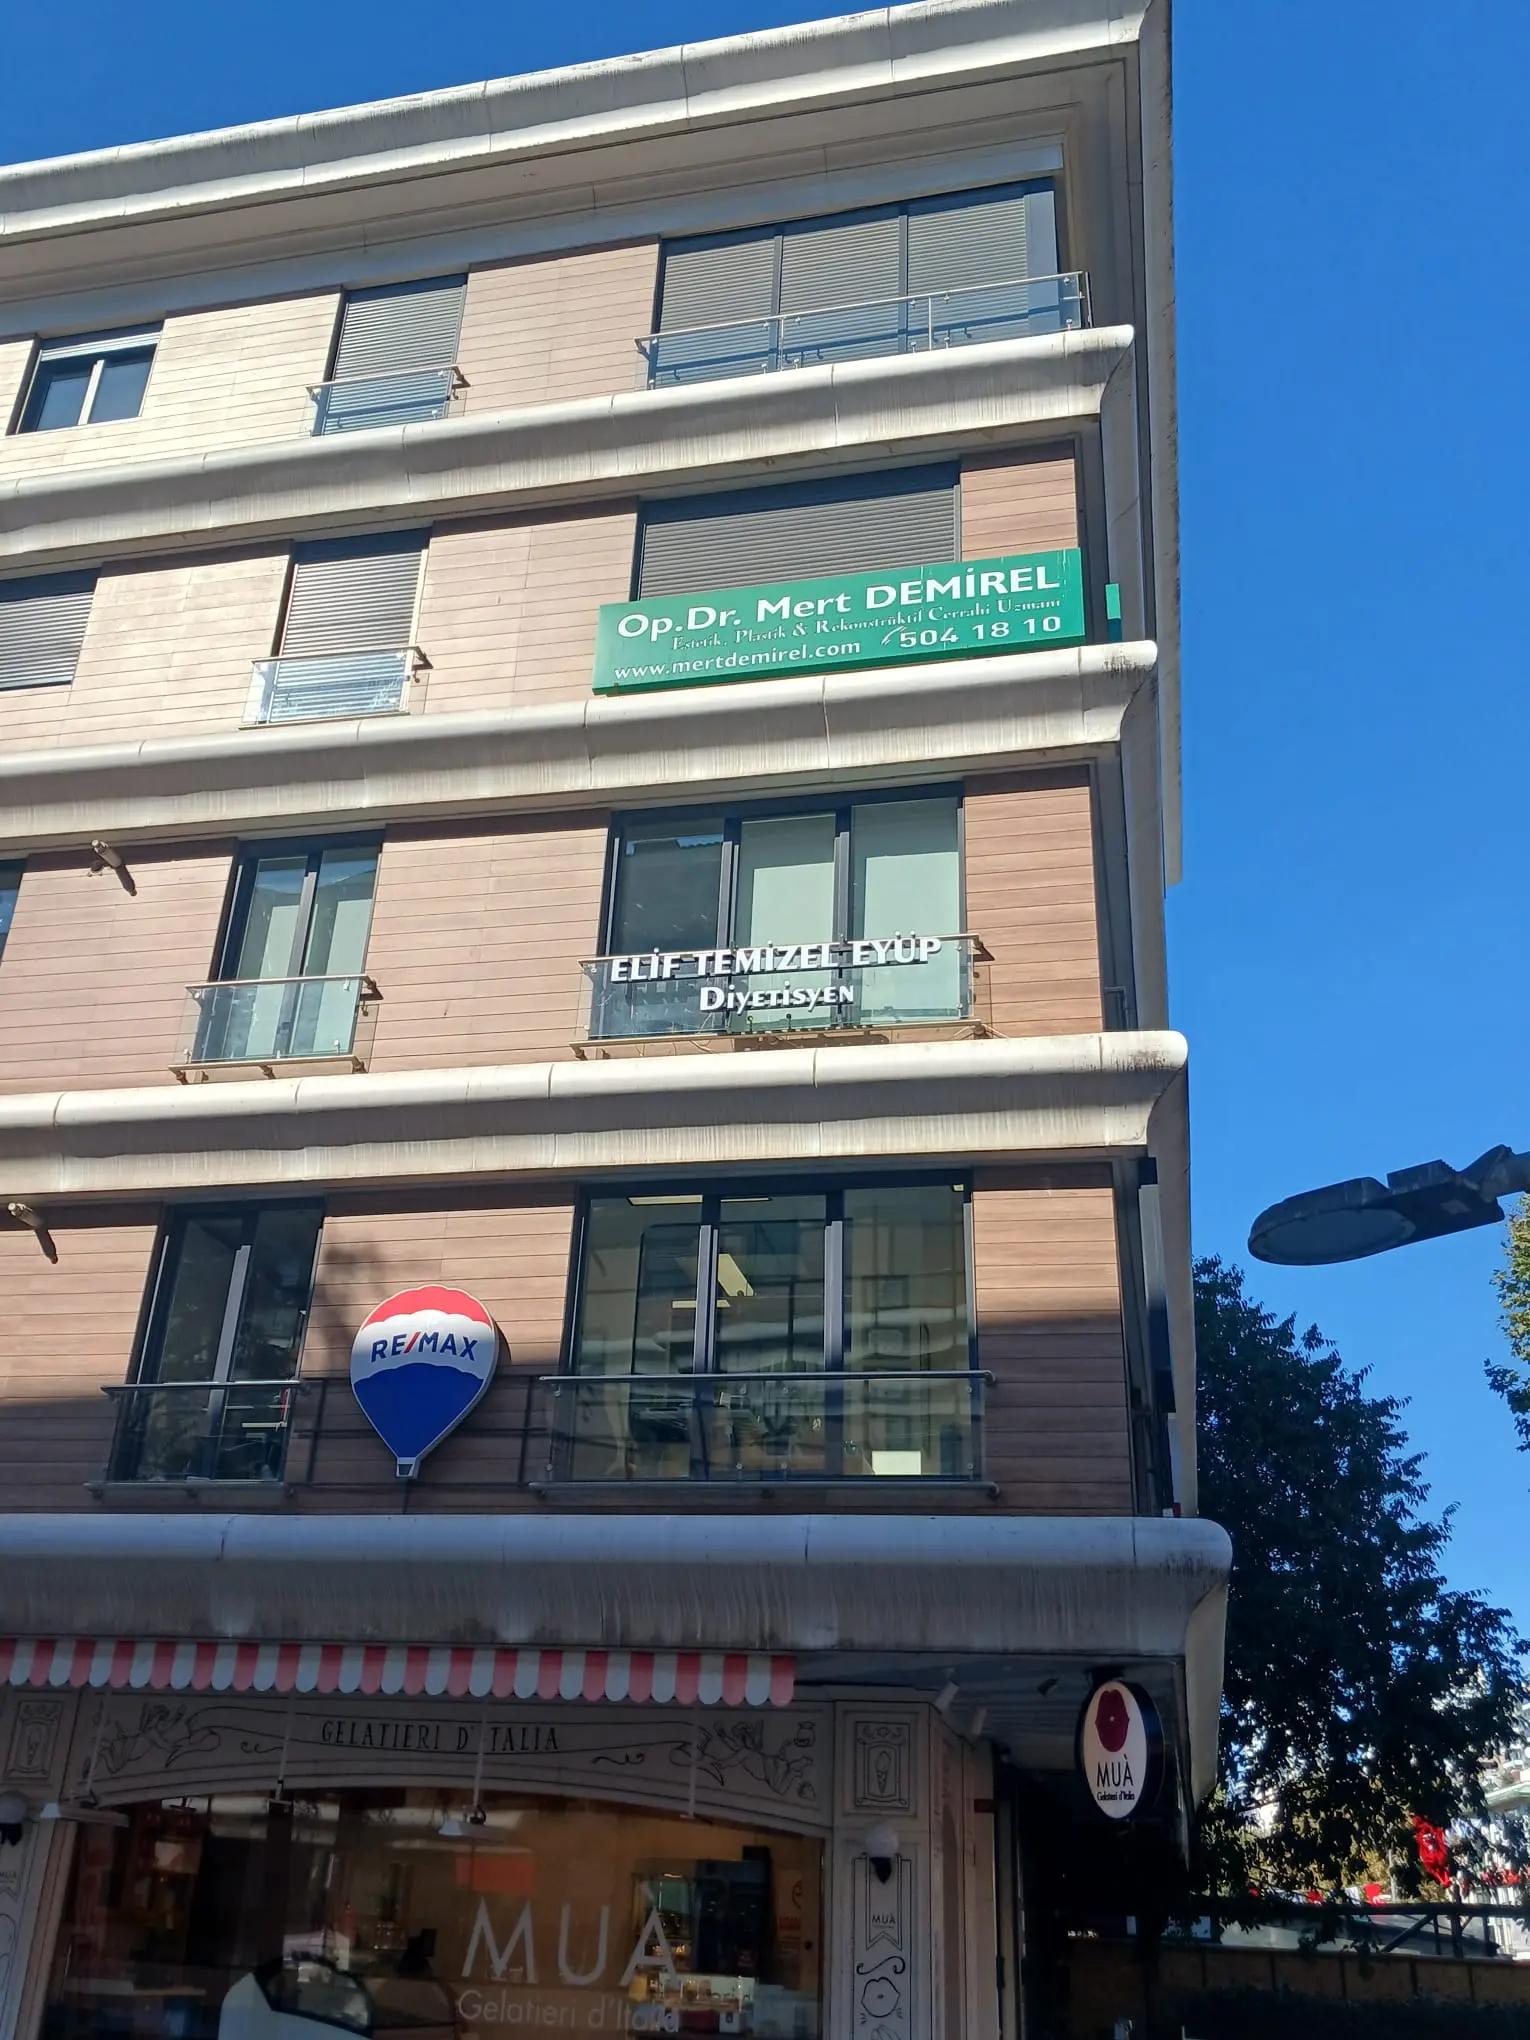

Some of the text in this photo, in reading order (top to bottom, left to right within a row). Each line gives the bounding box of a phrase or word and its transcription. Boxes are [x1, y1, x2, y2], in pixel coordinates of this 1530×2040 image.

[617, 566, 1061, 642] Op.Dr. Mert DEMİREL
[735, 625, 787, 644] Plastik
[791, 622, 808, 638] &
[900, 615, 1062, 649] 504 18 10
[614, 643, 862, 680] www.mertdemirel.com
[610, 931, 943, 983] ELİF TEMİZEL EYÜP
[370, 1331, 479, 1363] RE/MAX
[321, 1719, 440, 1750] GELATIERI
[1097, 1753, 1134, 1788] MUÀ
[461, 1882, 681, 1987] MUÀ
[458, 1988, 577, 2027] Gelatieri
